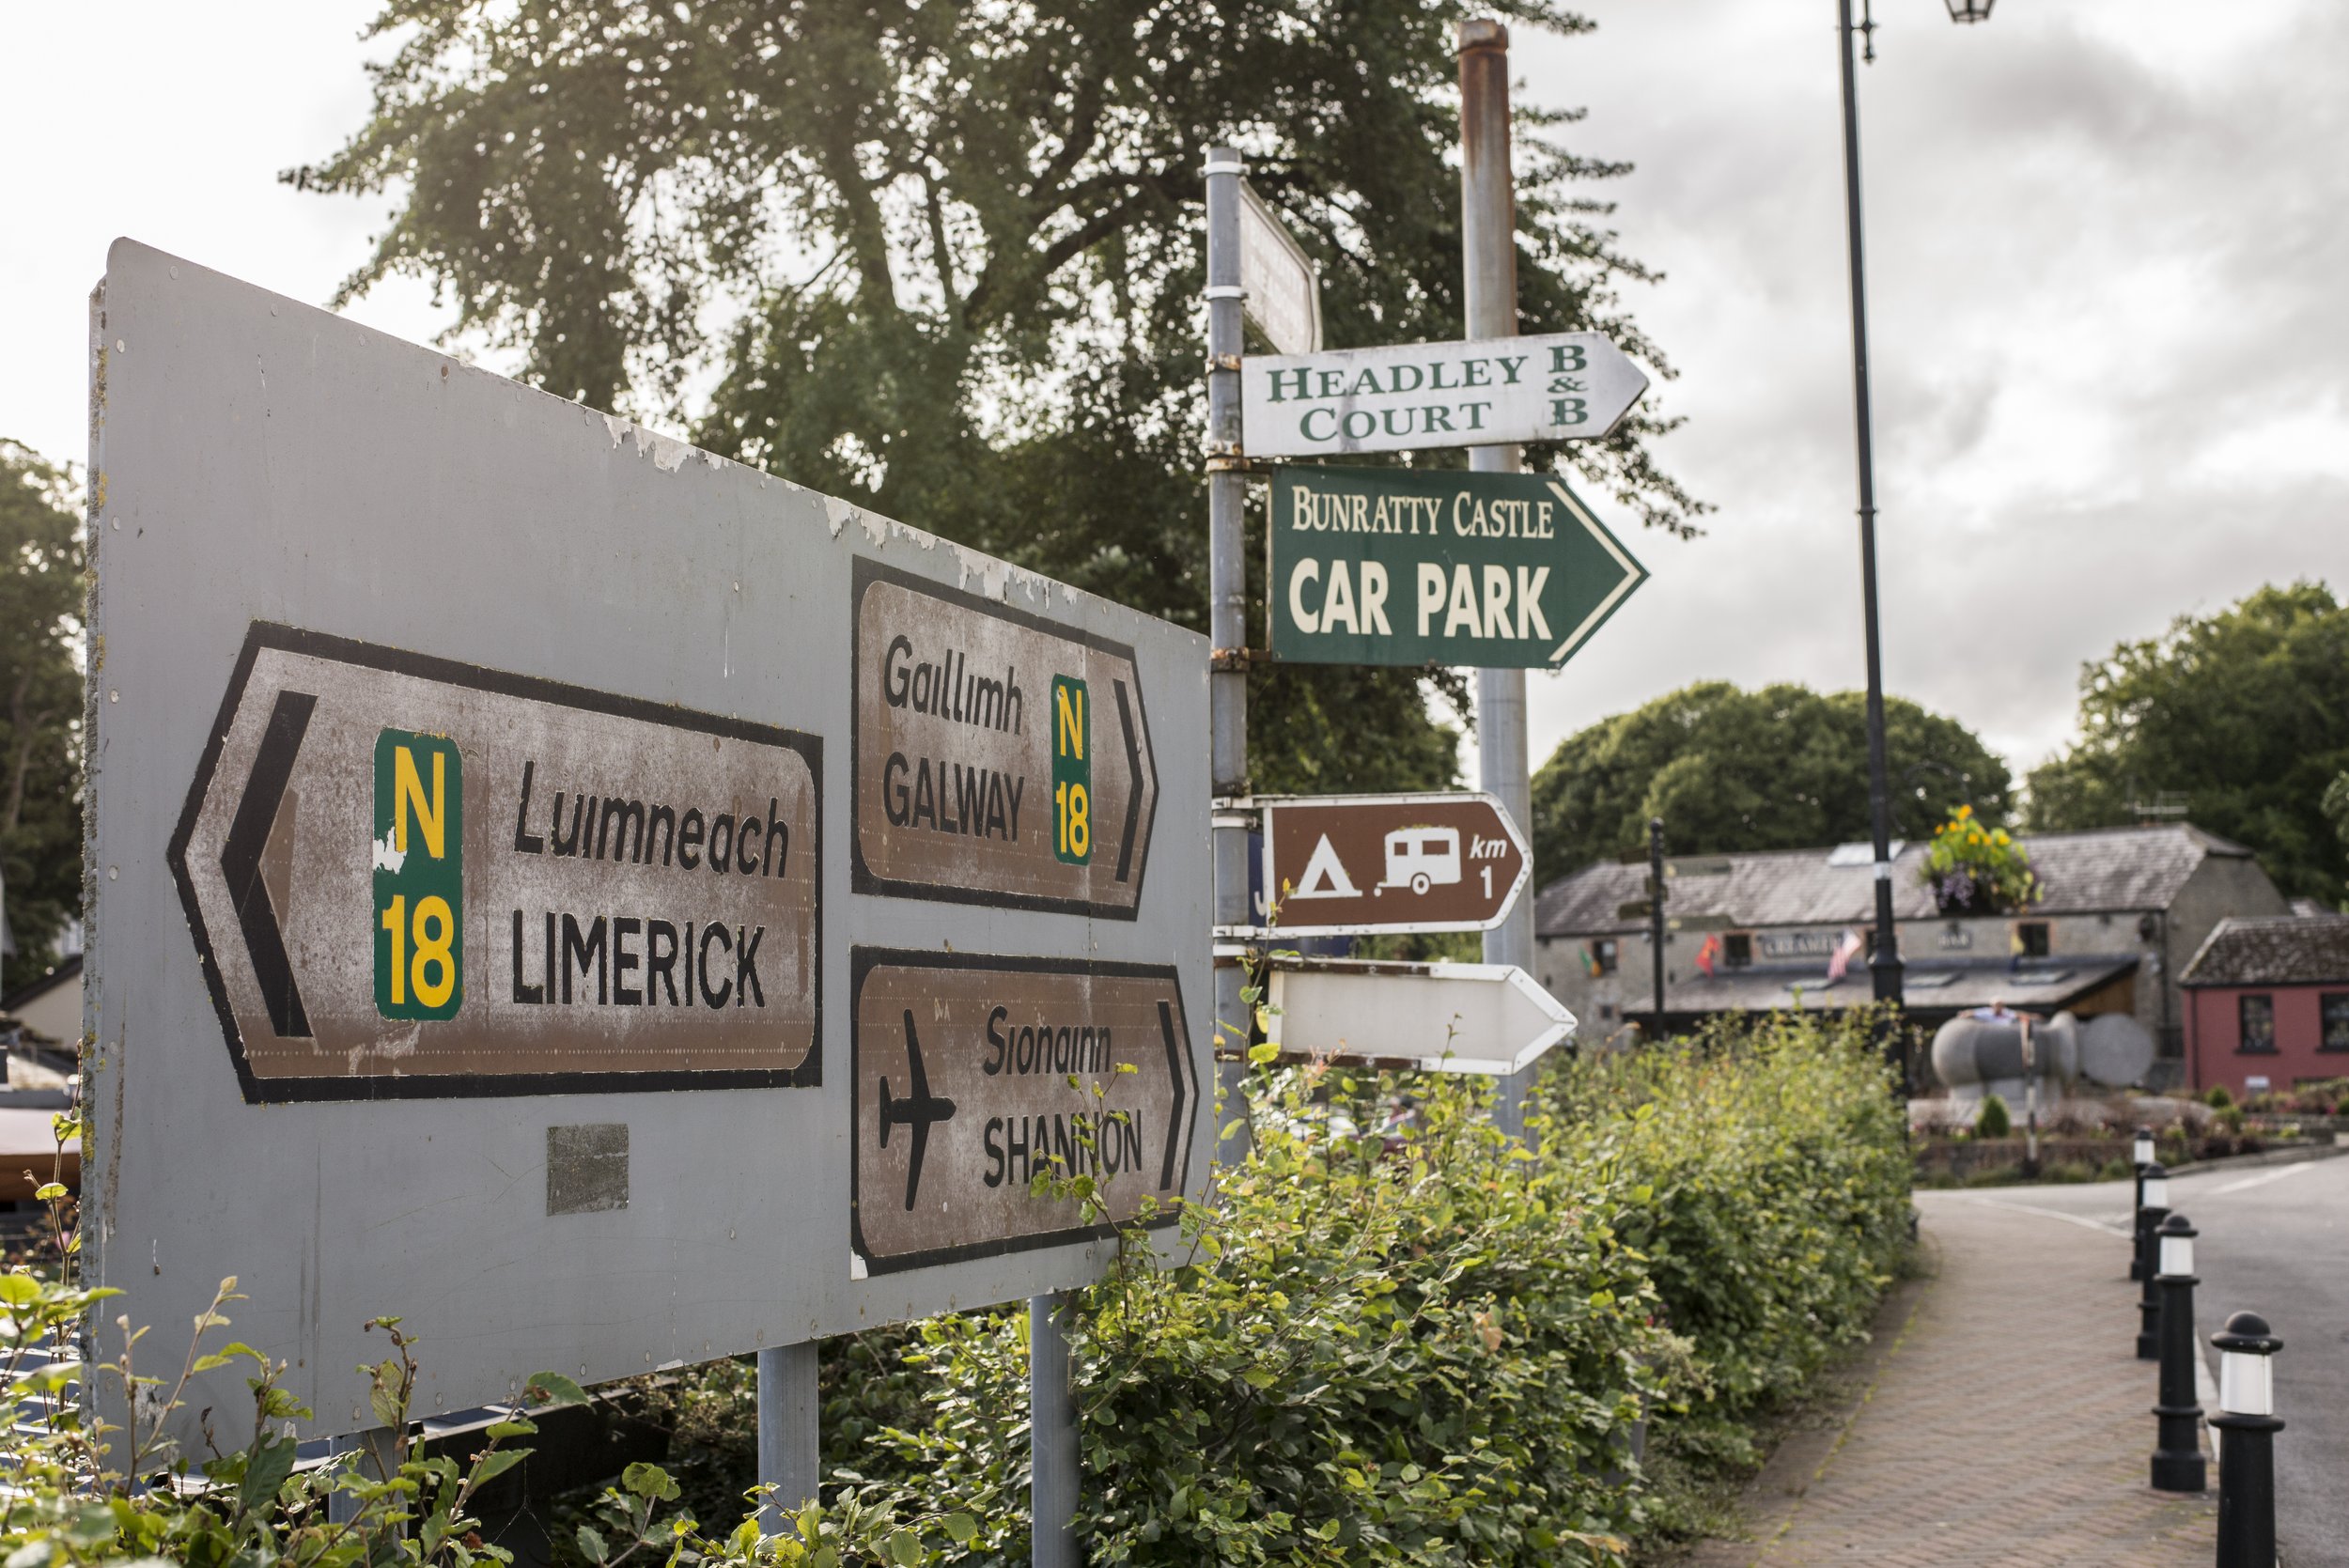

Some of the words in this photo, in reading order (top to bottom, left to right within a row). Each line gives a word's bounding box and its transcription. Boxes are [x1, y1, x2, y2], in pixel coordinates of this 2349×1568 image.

[1267, 355, 1529, 402] HEADLEY
[1299, 402, 1492, 442] COURT
[1291, 485, 1442, 536] BUNRATTY
[1453, 491, 1554, 539] CASTLE
[1288, 558, 1392, 636] CAR
[1417, 564, 1553, 641] PARK
[883, 634, 1023, 736] Gaillimh
[1058, 684, 1083, 760] N
[394, 746, 445, 860] N
[512, 759, 789, 878] Luimneach
[883, 751, 1025, 843] GALWAY
[1056, 781, 1089, 859] 18
[1469, 834, 1507, 860] km
[1480, 865, 1493, 899] 1
[381, 894, 457, 1010] 18
[512, 908, 767, 1010] LIMERICK
[983, 1108, 1142, 1188] SHANNON
